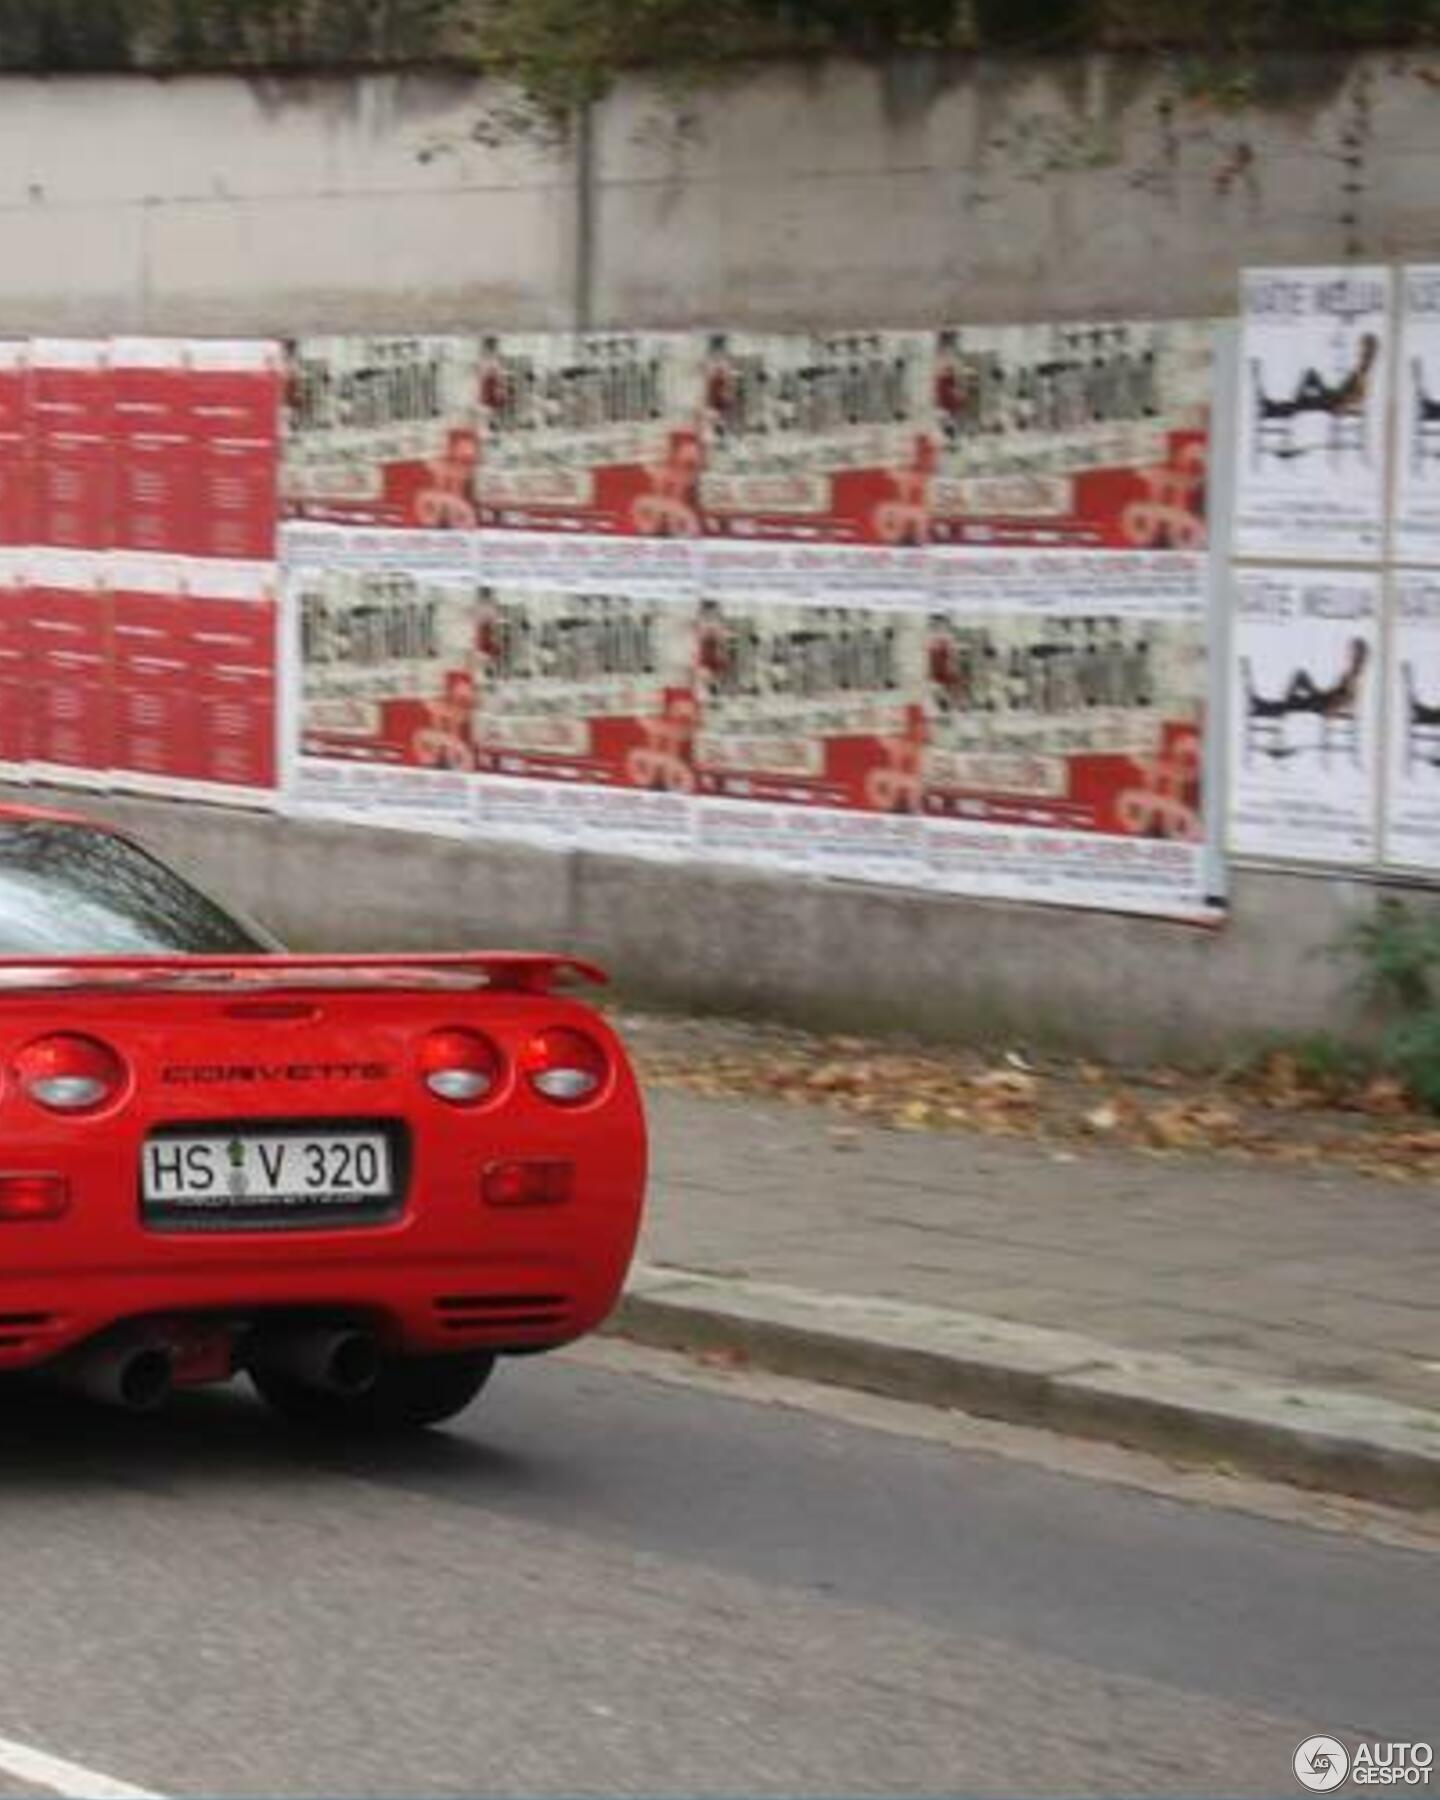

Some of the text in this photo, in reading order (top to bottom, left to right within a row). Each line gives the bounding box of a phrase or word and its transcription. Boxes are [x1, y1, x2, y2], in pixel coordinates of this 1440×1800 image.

[162, 1062, 390, 1084] CORVETTE
[152, 1143, 378, 1190] HS V 320
